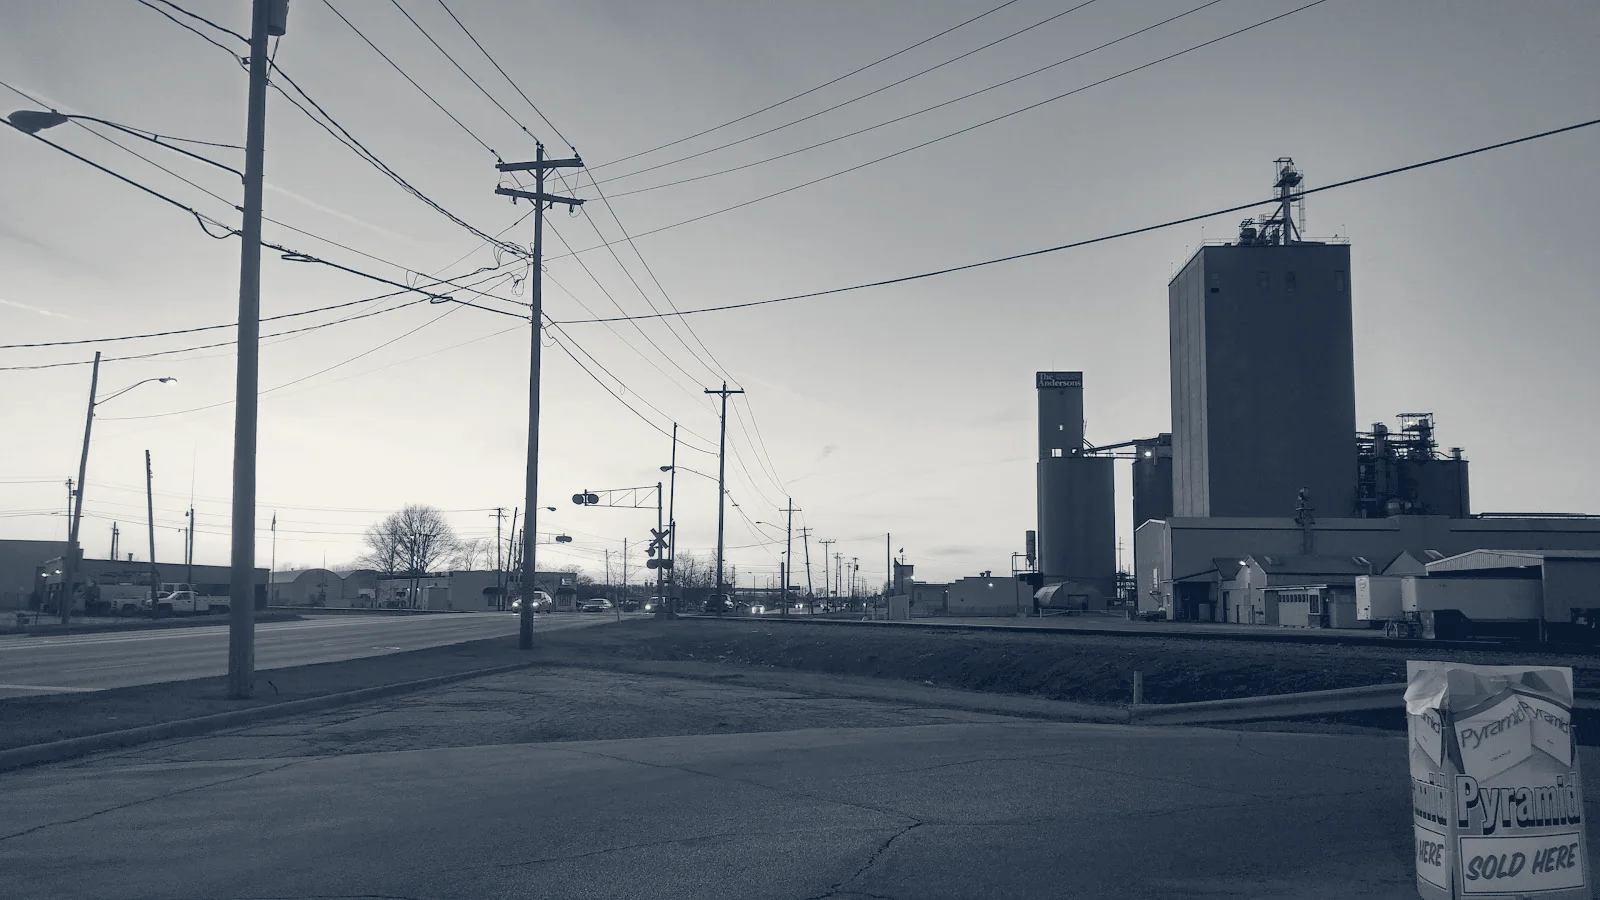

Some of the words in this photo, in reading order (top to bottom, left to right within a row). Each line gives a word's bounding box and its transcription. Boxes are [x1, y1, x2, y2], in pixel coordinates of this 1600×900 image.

[1039, 379, 1081, 387] Andersons
[1460, 704, 1526, 749] Pyramid
[1518, 701, 1569, 735] Pyramid
[1455, 773, 1581, 836] Pyramid
[1419, 839, 1445, 867] HERE
[1466, 852, 1526, 881] SOLD
[1532, 842, 1579, 874] HERE
